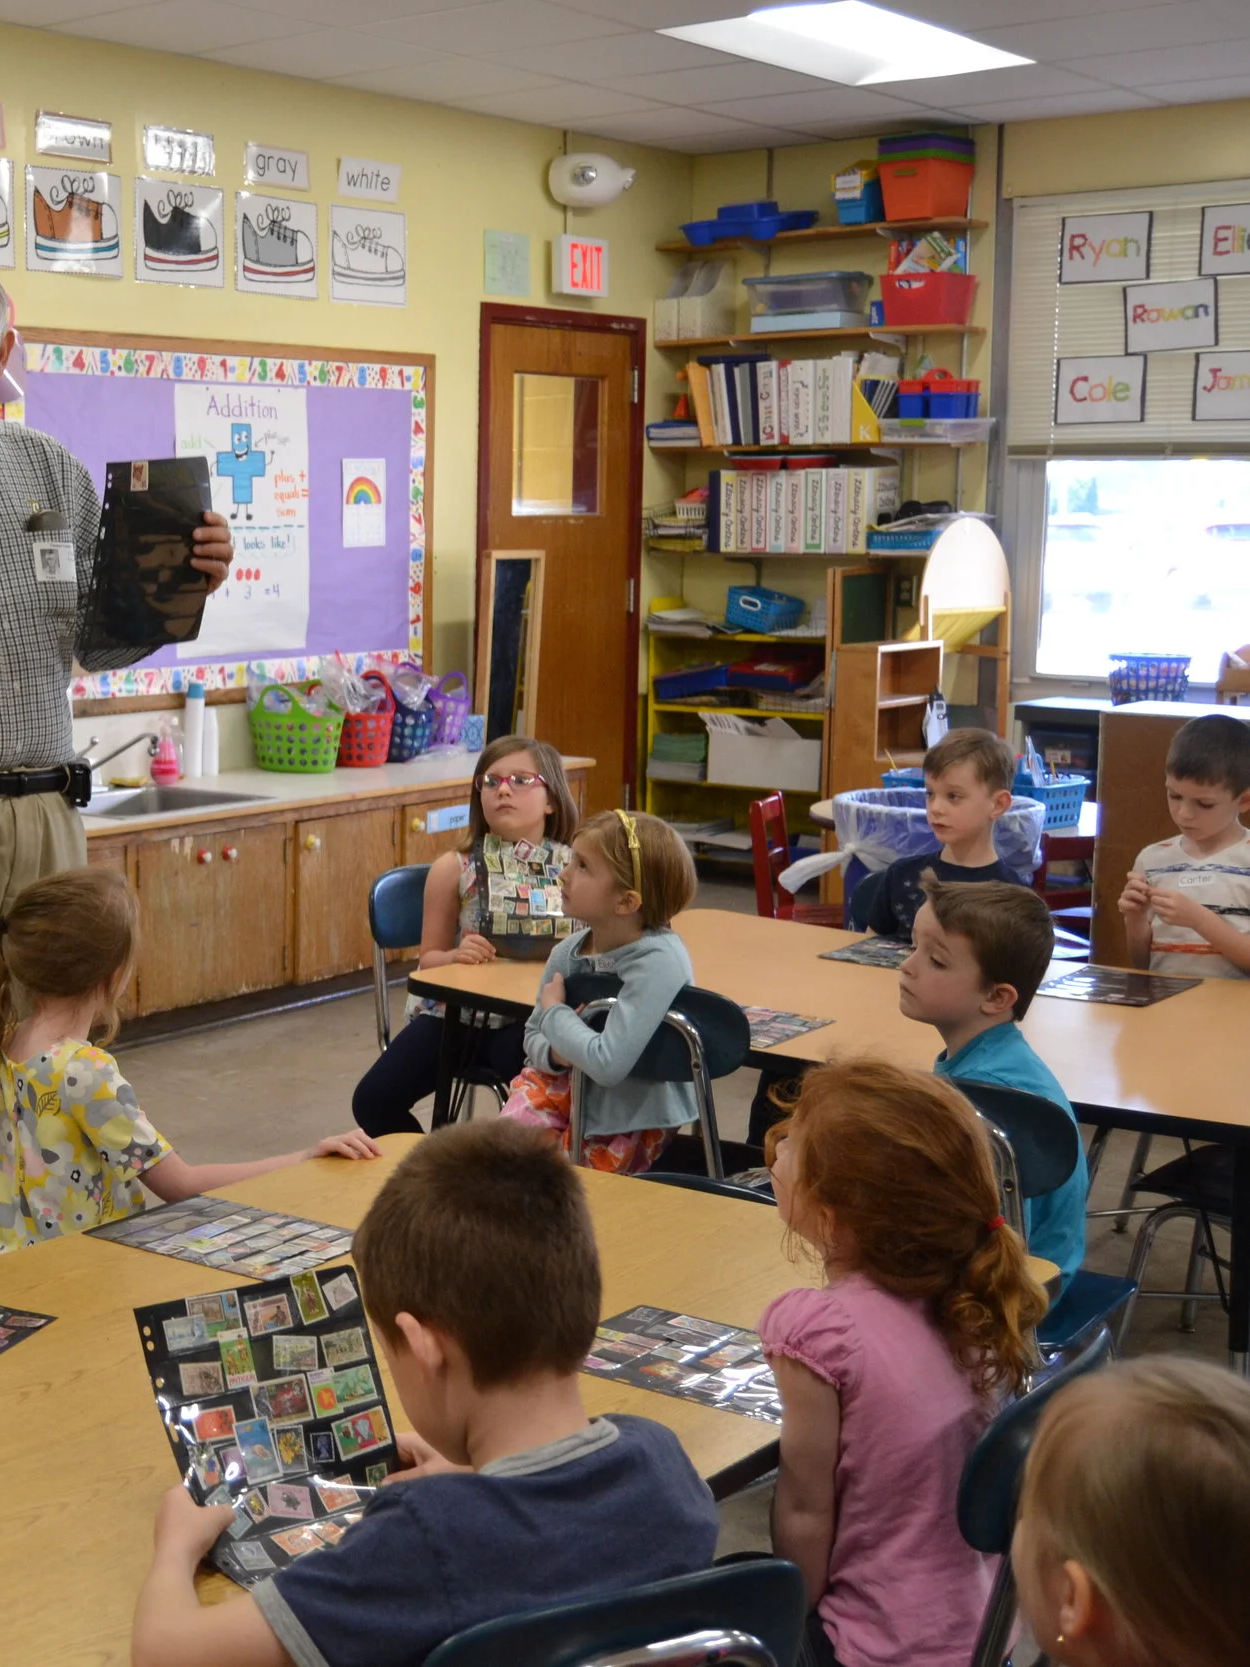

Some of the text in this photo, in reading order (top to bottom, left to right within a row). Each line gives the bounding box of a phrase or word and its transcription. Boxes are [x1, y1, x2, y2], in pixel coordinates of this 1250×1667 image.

[256, 153, 299, 181] gray
[345, 169, 392, 192] white
[1068, 232, 1141, 268] Ryan
[569, 243, 603, 292] EXIT
[1132, 303, 1210, 325] Rowan
[52, 346, 421, 391] 3 4 5 6 7 8 9 1 2 3 4 5 6 7 8 9 1 2
[1069, 374, 1131, 403] Cole
[206, 395, 279, 420] Addition
[859, 425, 872, 441] K
[274, 470, 295, 488] plus
[276, 508, 297, 518] sum
[243, 536, 266, 551] looks
